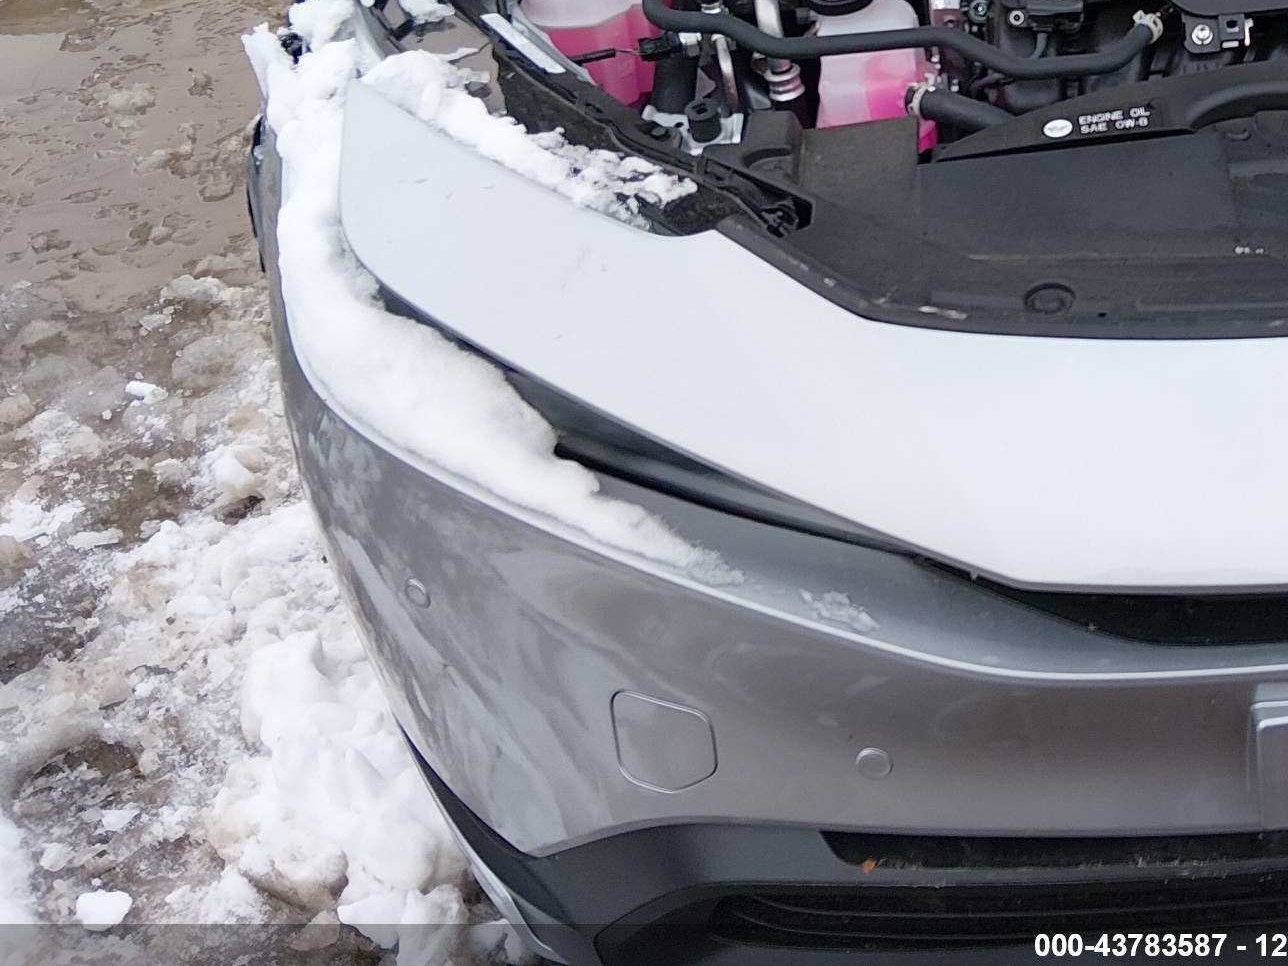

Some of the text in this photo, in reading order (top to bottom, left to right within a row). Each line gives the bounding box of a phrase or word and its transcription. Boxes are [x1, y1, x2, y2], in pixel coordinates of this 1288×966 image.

[1079, 106, 1150, 125] ENGINE OIL
[1080, 122, 1108, 134] SAE
